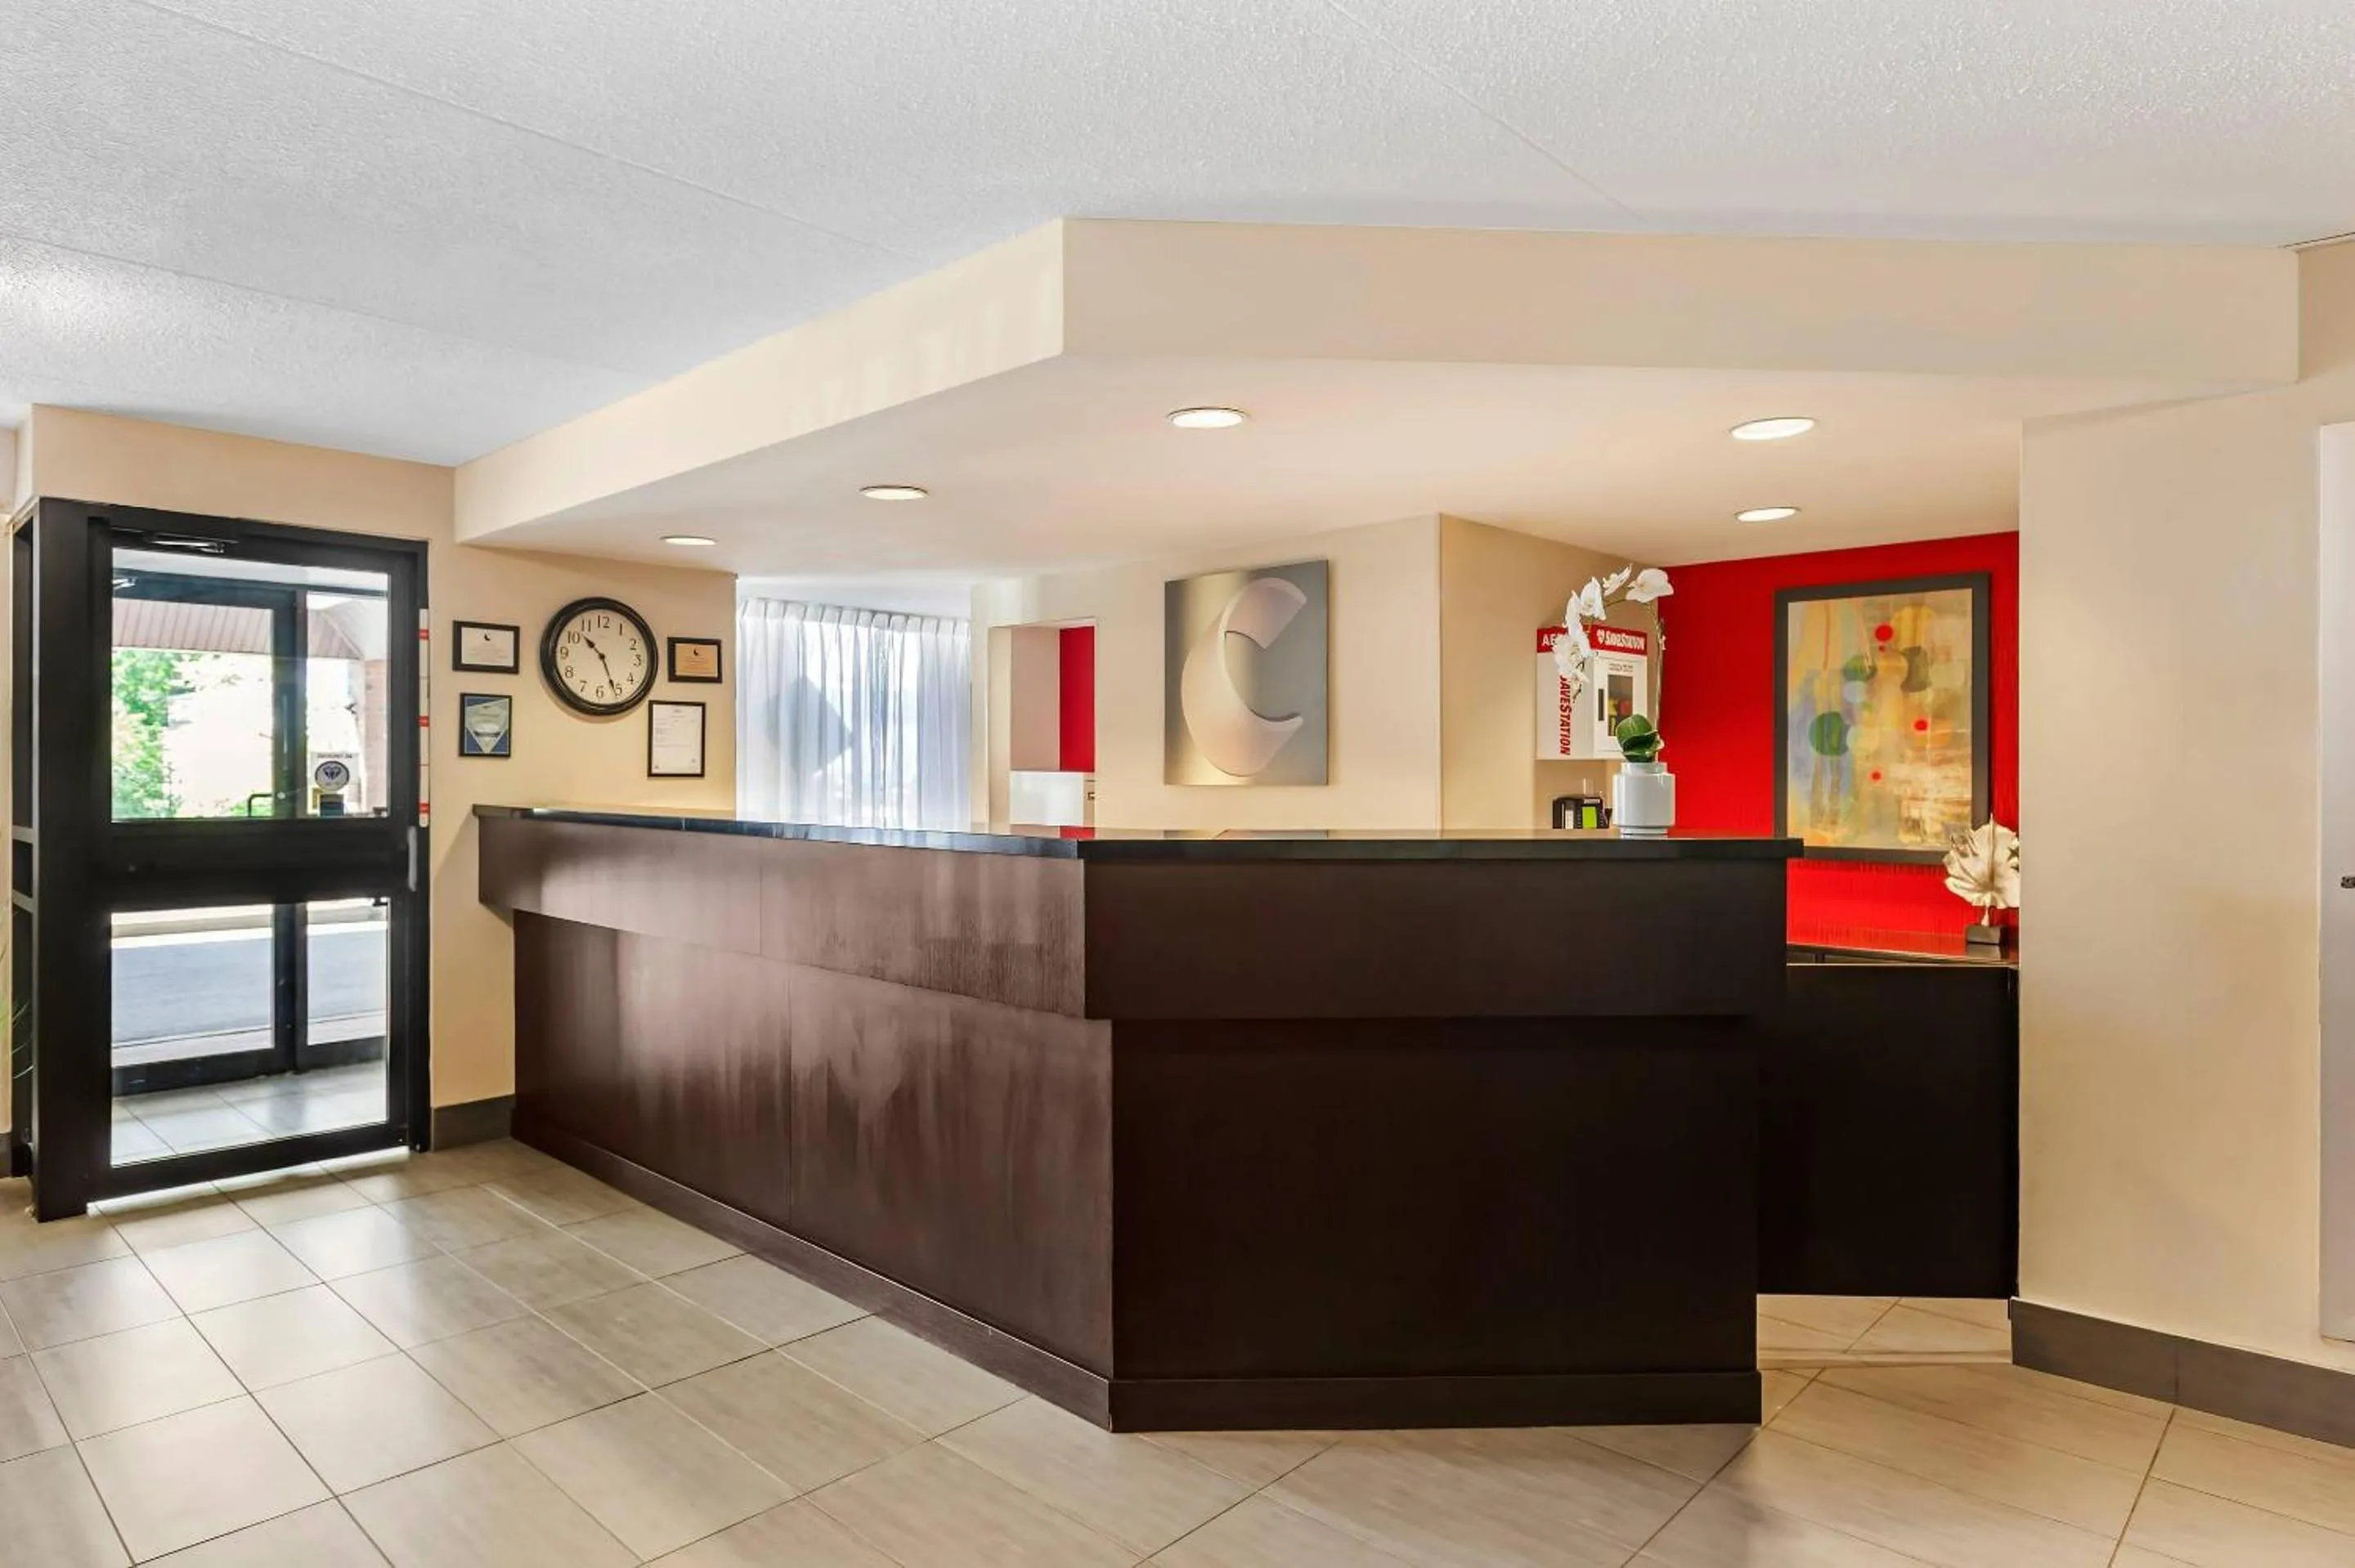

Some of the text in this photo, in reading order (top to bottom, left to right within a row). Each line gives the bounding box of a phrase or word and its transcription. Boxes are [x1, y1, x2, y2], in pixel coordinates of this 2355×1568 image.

[581, 619, 591, 632] 11
[598, 615, 610, 629] 12
[567, 631, 581, 644] 10
[630, 638, 637, 651] 2
[560, 646, 569, 660] 9
[633, 654, 641, 667] 3
[564, 665, 573, 679] 8
[580, 679, 587, 692] 7
[627, 673, 634, 685] 4
[596, 686, 603, 698] 6
